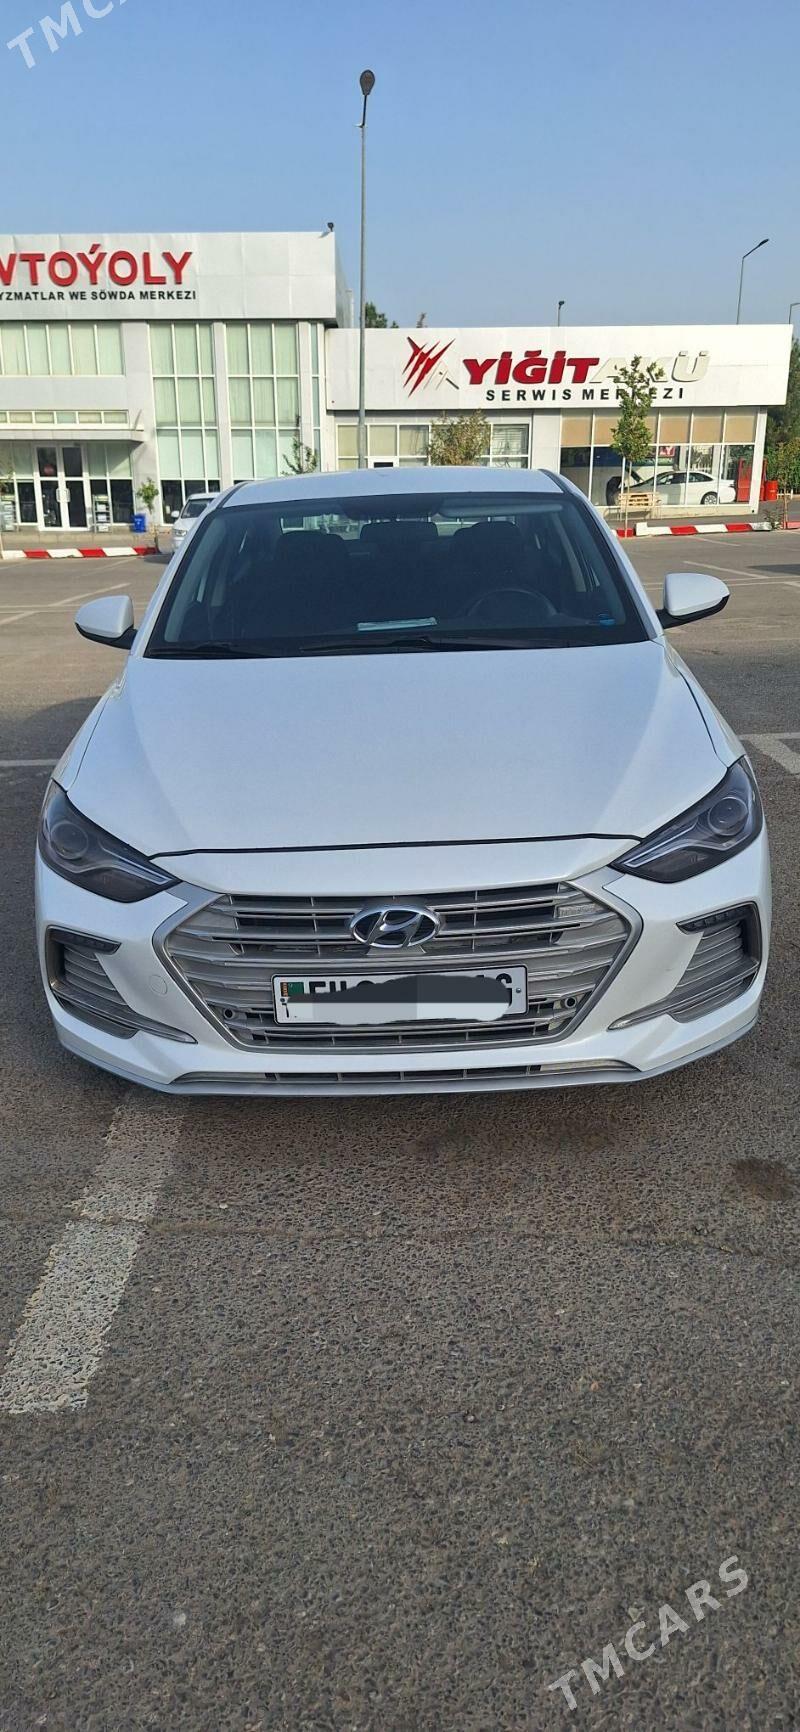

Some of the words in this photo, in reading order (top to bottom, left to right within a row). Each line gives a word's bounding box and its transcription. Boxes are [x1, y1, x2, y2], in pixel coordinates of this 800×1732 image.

[68, 291, 87, 301] WE
[91, 289, 135, 300] SÖWDA
[139, 290, 197, 300] MERKEZI
[485, 388, 572, 401] SERWIS
